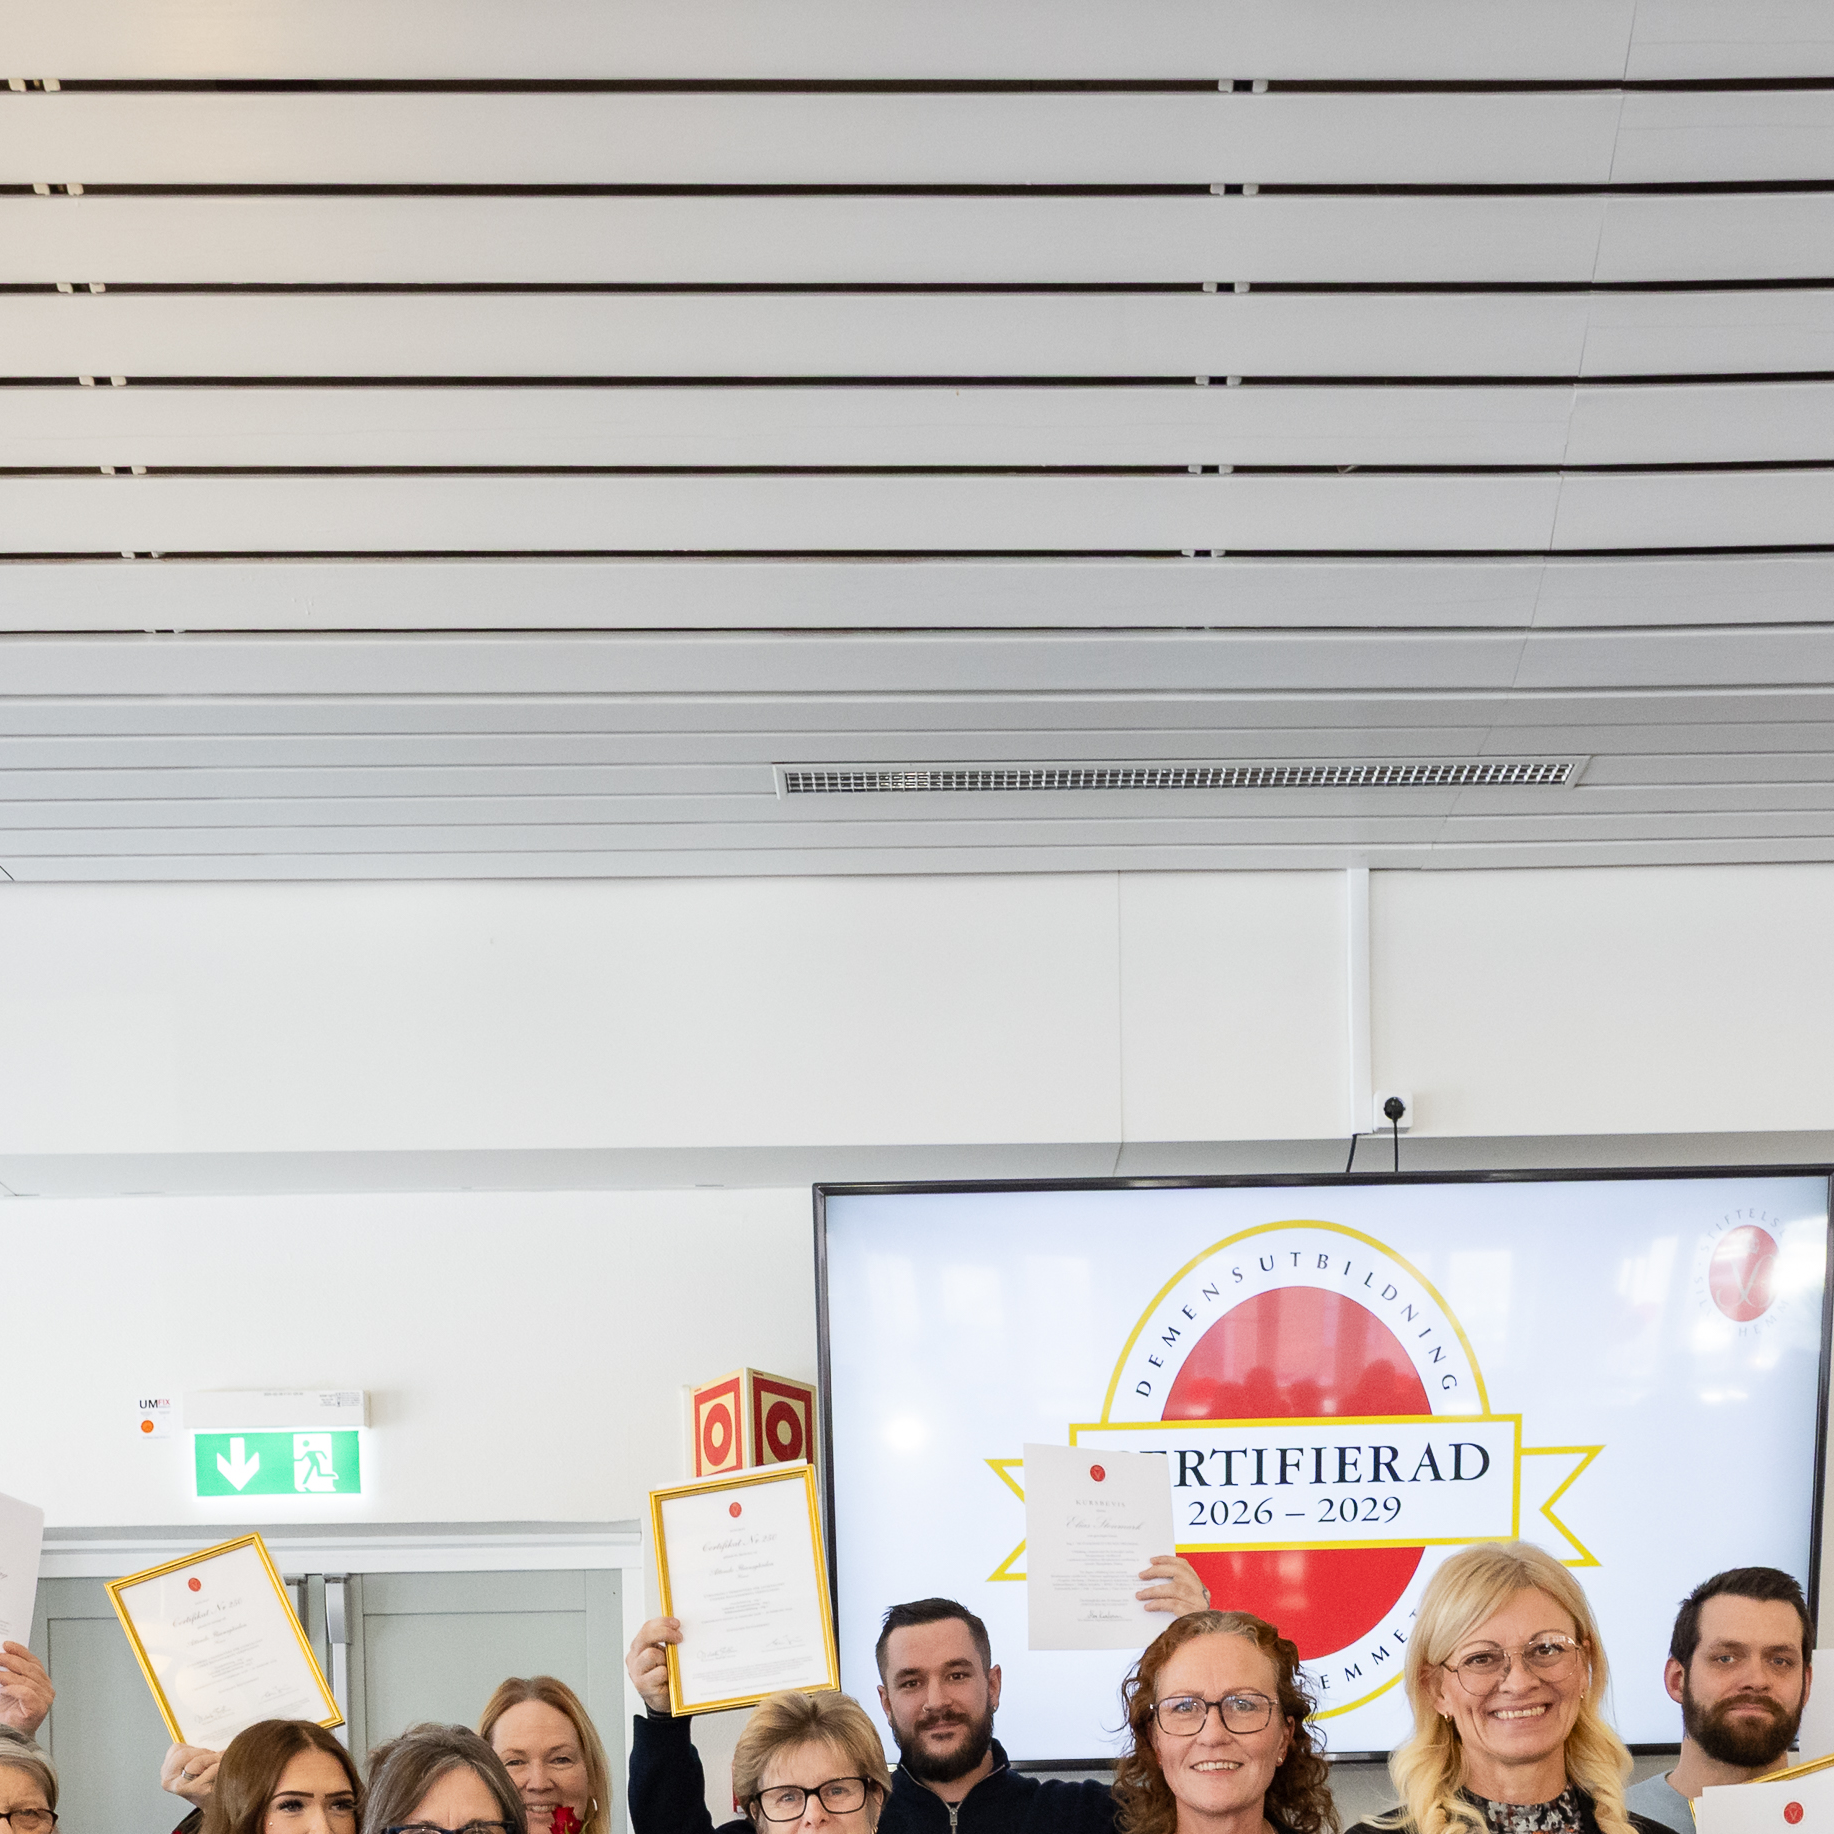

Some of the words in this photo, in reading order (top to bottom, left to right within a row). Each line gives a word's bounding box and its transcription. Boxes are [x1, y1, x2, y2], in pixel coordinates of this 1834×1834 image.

[1135, 1251, 1458, 1398] DEMENSUTBILDNING
[1120, 1441, 1491, 1488] RTIFIERAD
[1188, 1496, 1274, 1526] 2026
[1317, 1495, 1402, 1525] 2029
